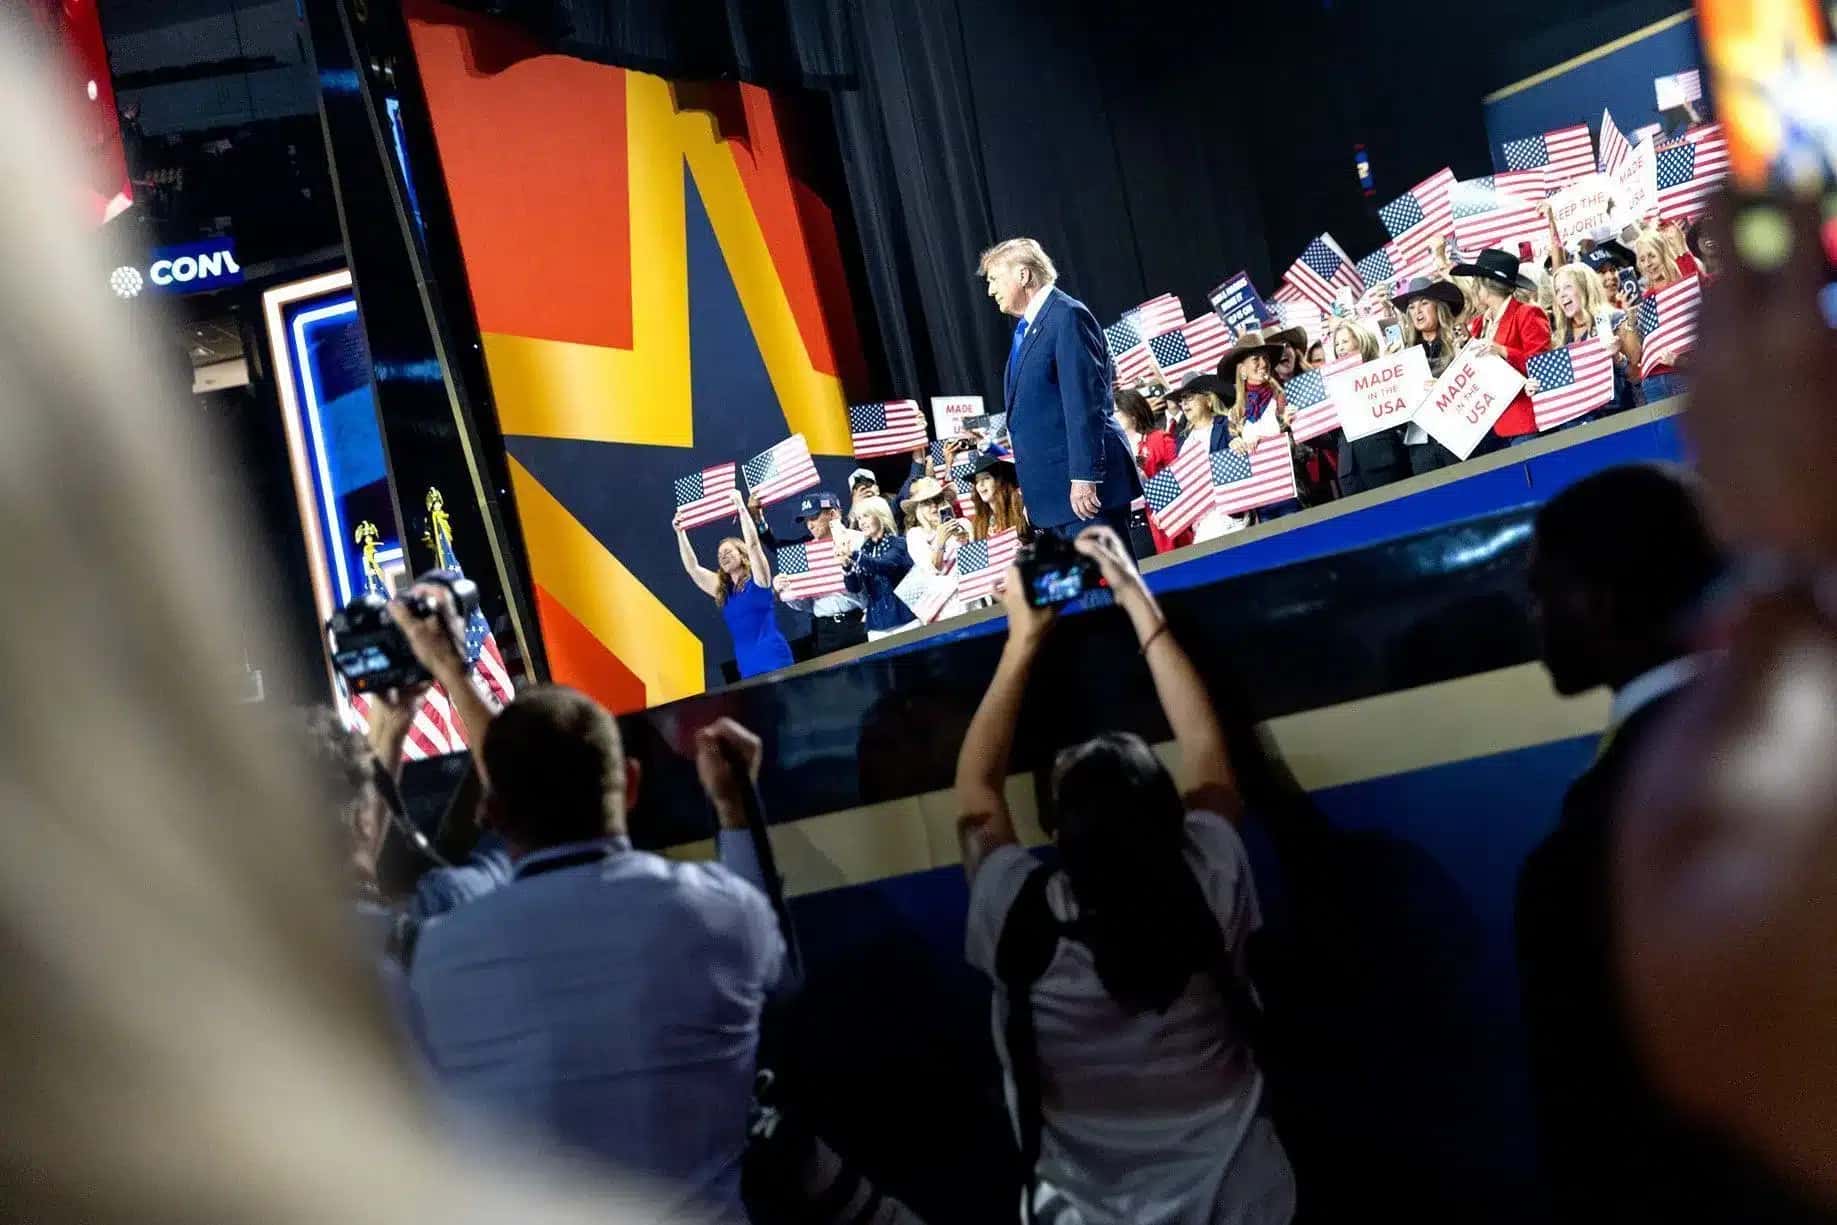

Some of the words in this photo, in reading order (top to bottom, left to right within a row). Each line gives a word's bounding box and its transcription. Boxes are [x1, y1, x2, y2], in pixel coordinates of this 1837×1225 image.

[1557, 203, 1577, 220] EEP
[1580, 192, 1606, 208] THE
[1563, 212, 1604, 238] AJORIT
[1354, 363, 1404, 392] MADE
[1435, 363, 1475, 412] MADE
[1368, 392, 1377, 400] IN
[1381, 385, 1398, 397] THE
[945, 404, 974, 414] MADE
[1372, 398, 1406, 418] USA
[1466, 393, 1496, 423] USA
